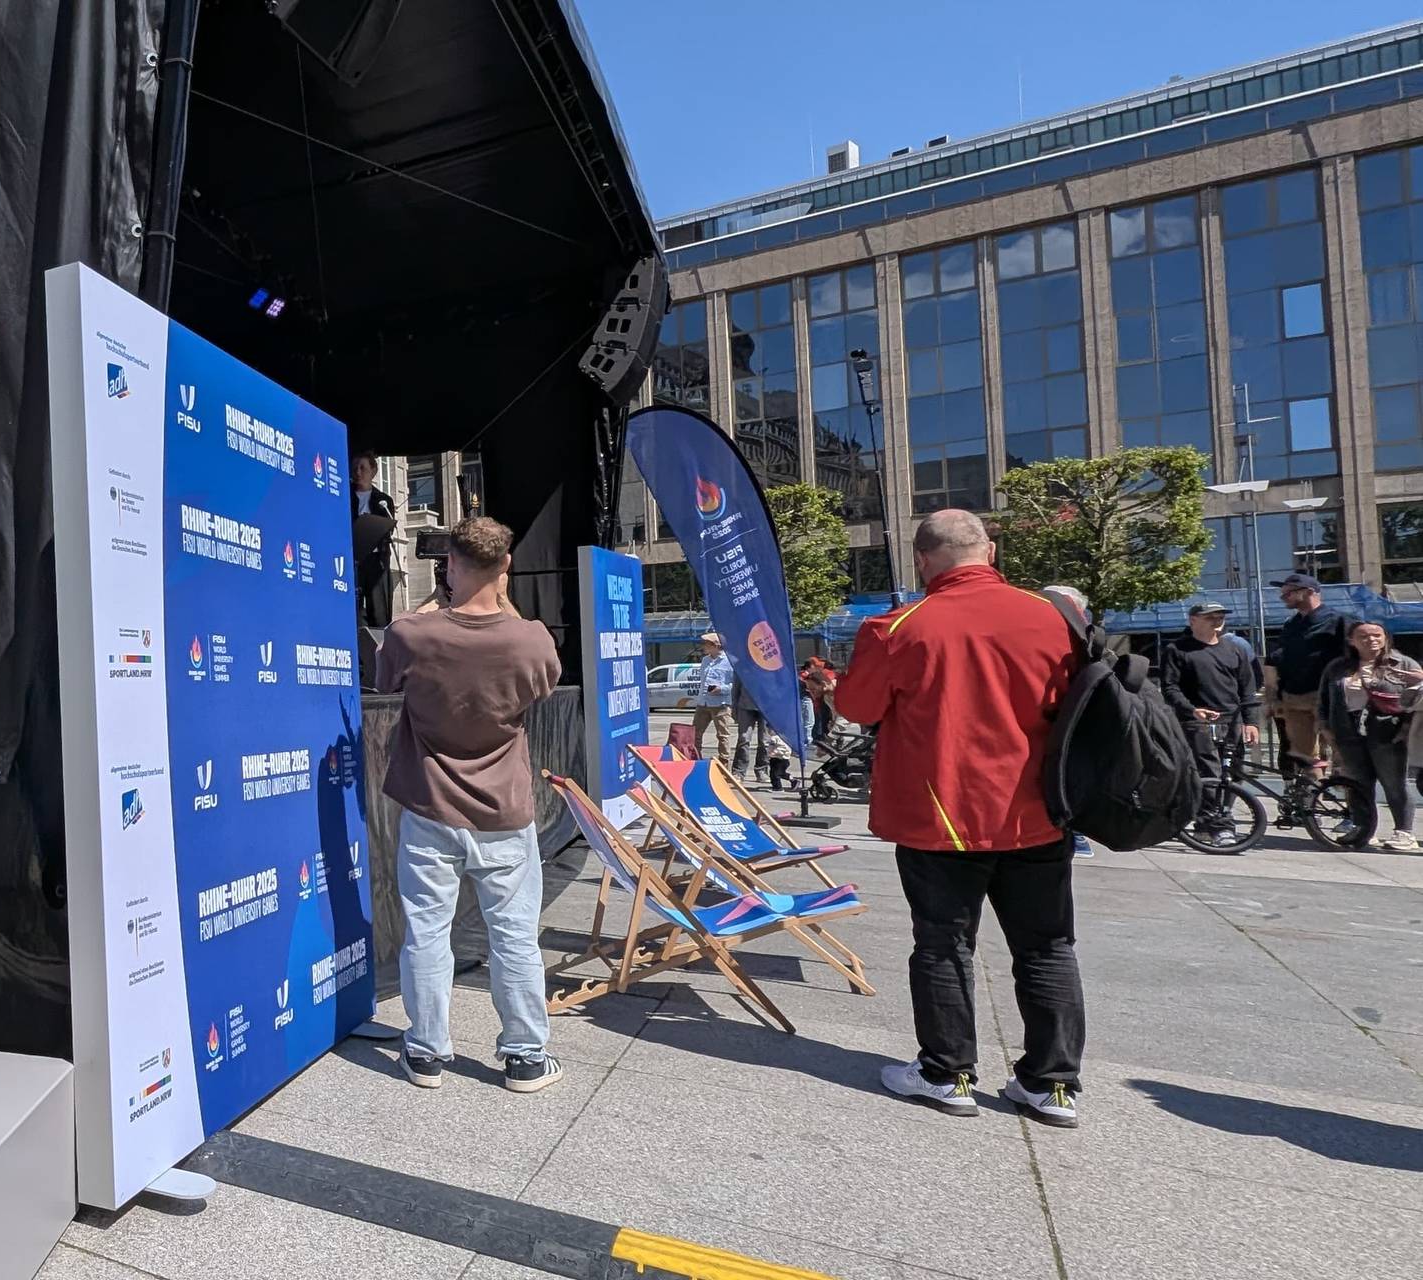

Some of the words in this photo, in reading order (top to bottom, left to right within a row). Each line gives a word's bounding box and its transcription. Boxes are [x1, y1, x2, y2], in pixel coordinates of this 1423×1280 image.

[177, 411, 201, 433] FISU
[225, 403, 276, 449] RHINE-RUHR
[275, 430, 294, 458] 2025
[227, 429, 239, 451] FISU
[238, 434, 256, 459] WORLD
[256, 443, 281, 470] UNIVERSITY
[280, 455, 296, 477] GAMES
[181, 504, 240, 544] RHINE-RUHR
[239, 523, 261, 550] 2025
[182, 532, 196, 554] FISU
[196, 535, 217, 559] WORLD
[216, 541, 246, 567] UNIVERSITY
[245, 549, 263, 571] GAMES
[333, 579, 348, 592] FISU
[212, 635, 226, 644] FISU
[296, 644, 337, 668] RHINE-RUHR
[335, 648, 352, 669] 2025
[258, 670, 277, 684] FISU
[241, 751, 291, 780] RHINE-RUHR
[290, 748, 310, 772] 2025
[243, 780, 255, 801] FISU
[254, 779, 272, 799] WORLD
[271, 775, 296, 796] UNIVERSITY
[296, 772, 311, 792] GAMES
[194, 793, 218, 811] FISU
[699, 806, 721, 816] FISU
[700, 815, 732, 825] WORLD
[198, 874, 257, 919] RHINE-RUHR
[256, 867, 278, 898] 2025
[199, 917, 214, 943] FISU
[213, 909, 234, 937] WORLD
[233, 899, 261, 929] UNIVERSITY
[261, 892, 280, 917] GAMES
[311, 945, 352, 987] RHINE-RUHR
[351, 937, 366, 964] 2025
[229, 1004, 243, 1019] FISU
[274, 1008, 295, 1031] FISU
